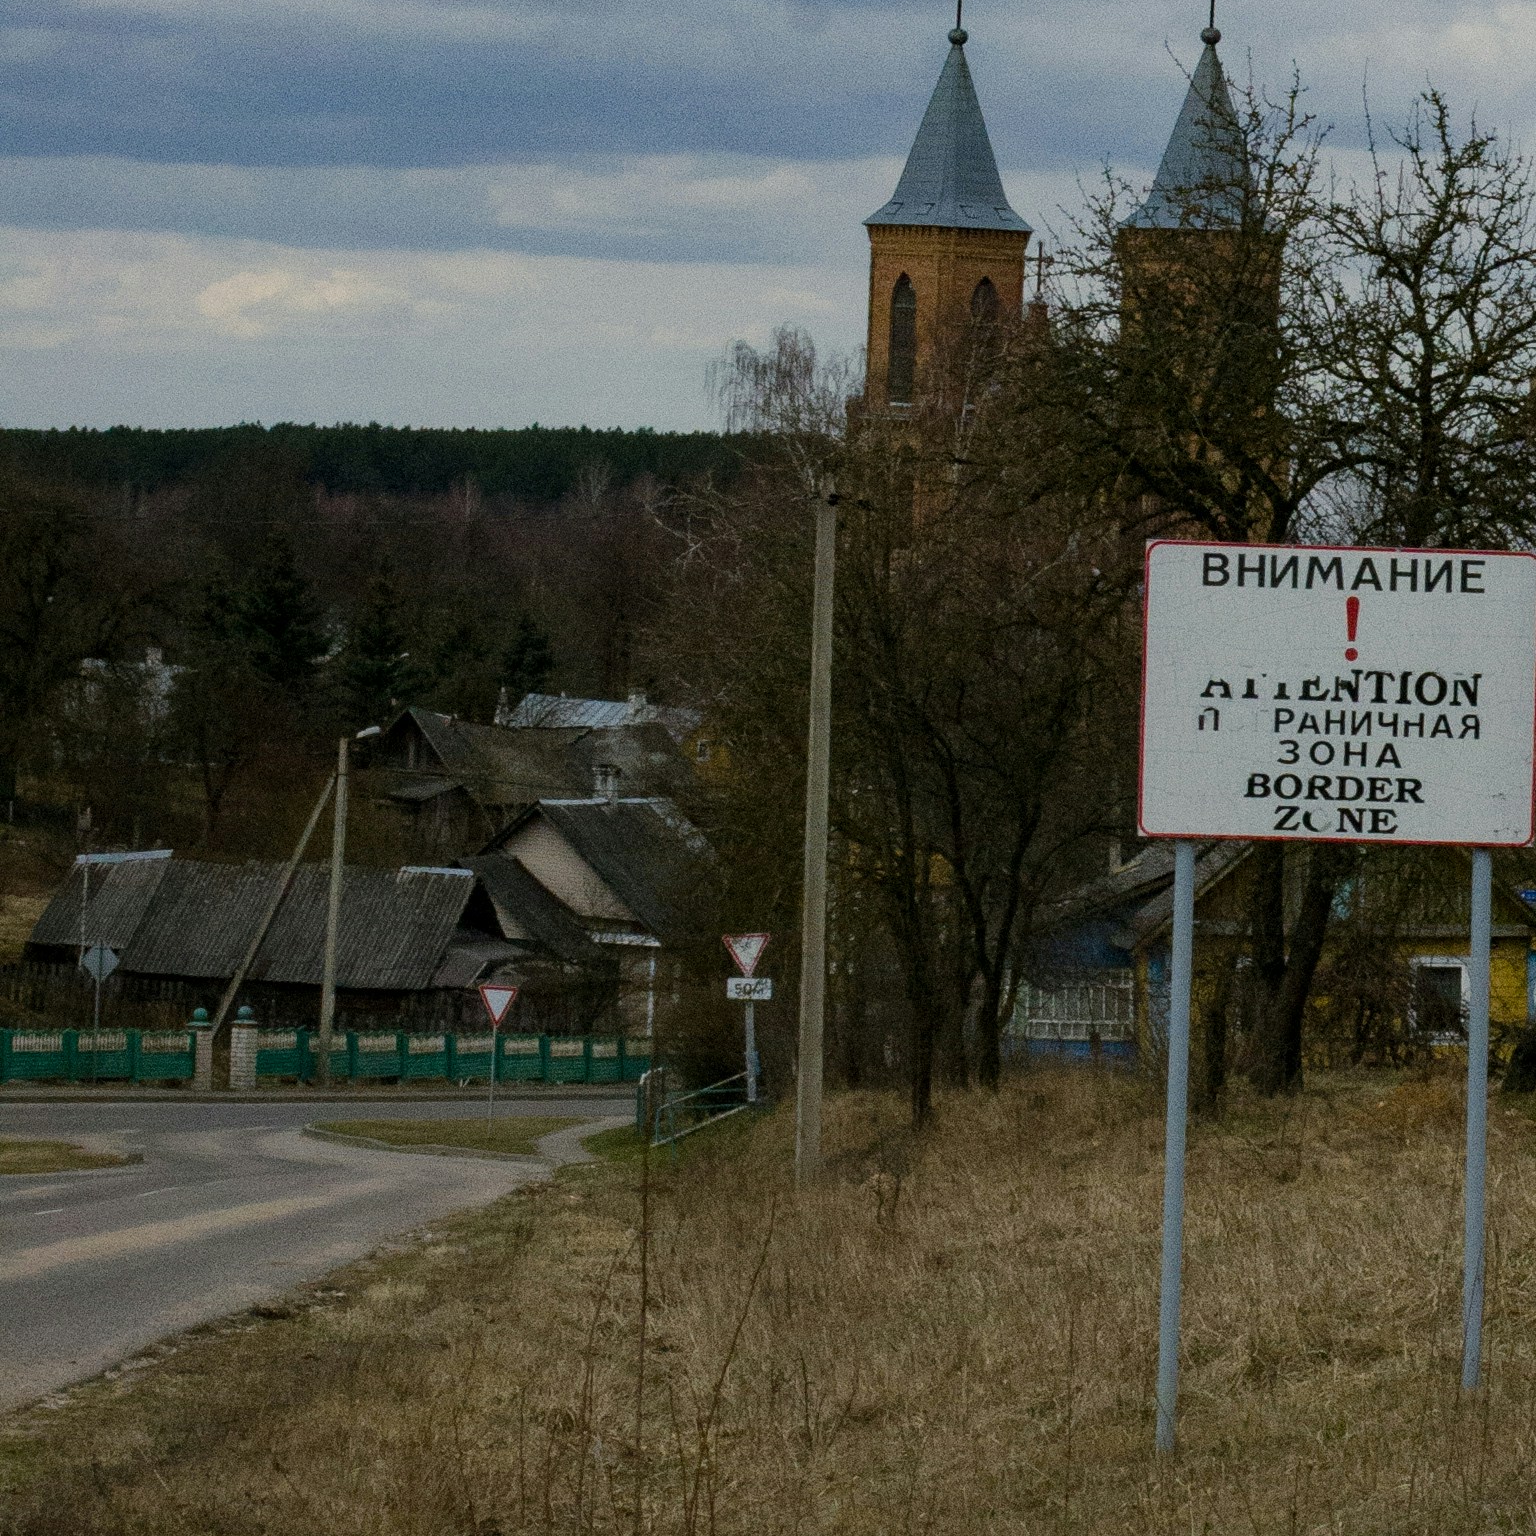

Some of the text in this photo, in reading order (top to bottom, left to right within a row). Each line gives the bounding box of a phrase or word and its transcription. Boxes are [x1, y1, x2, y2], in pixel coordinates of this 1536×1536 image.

[1202, 552, 1486, 594] ВНИМАНИЕ
[1198, 706, 1481, 740] ПРАНИЧНАЯ
[1276, 739, 1402, 769] ЗОНА
[1243, 772, 1425, 804] BORDER
